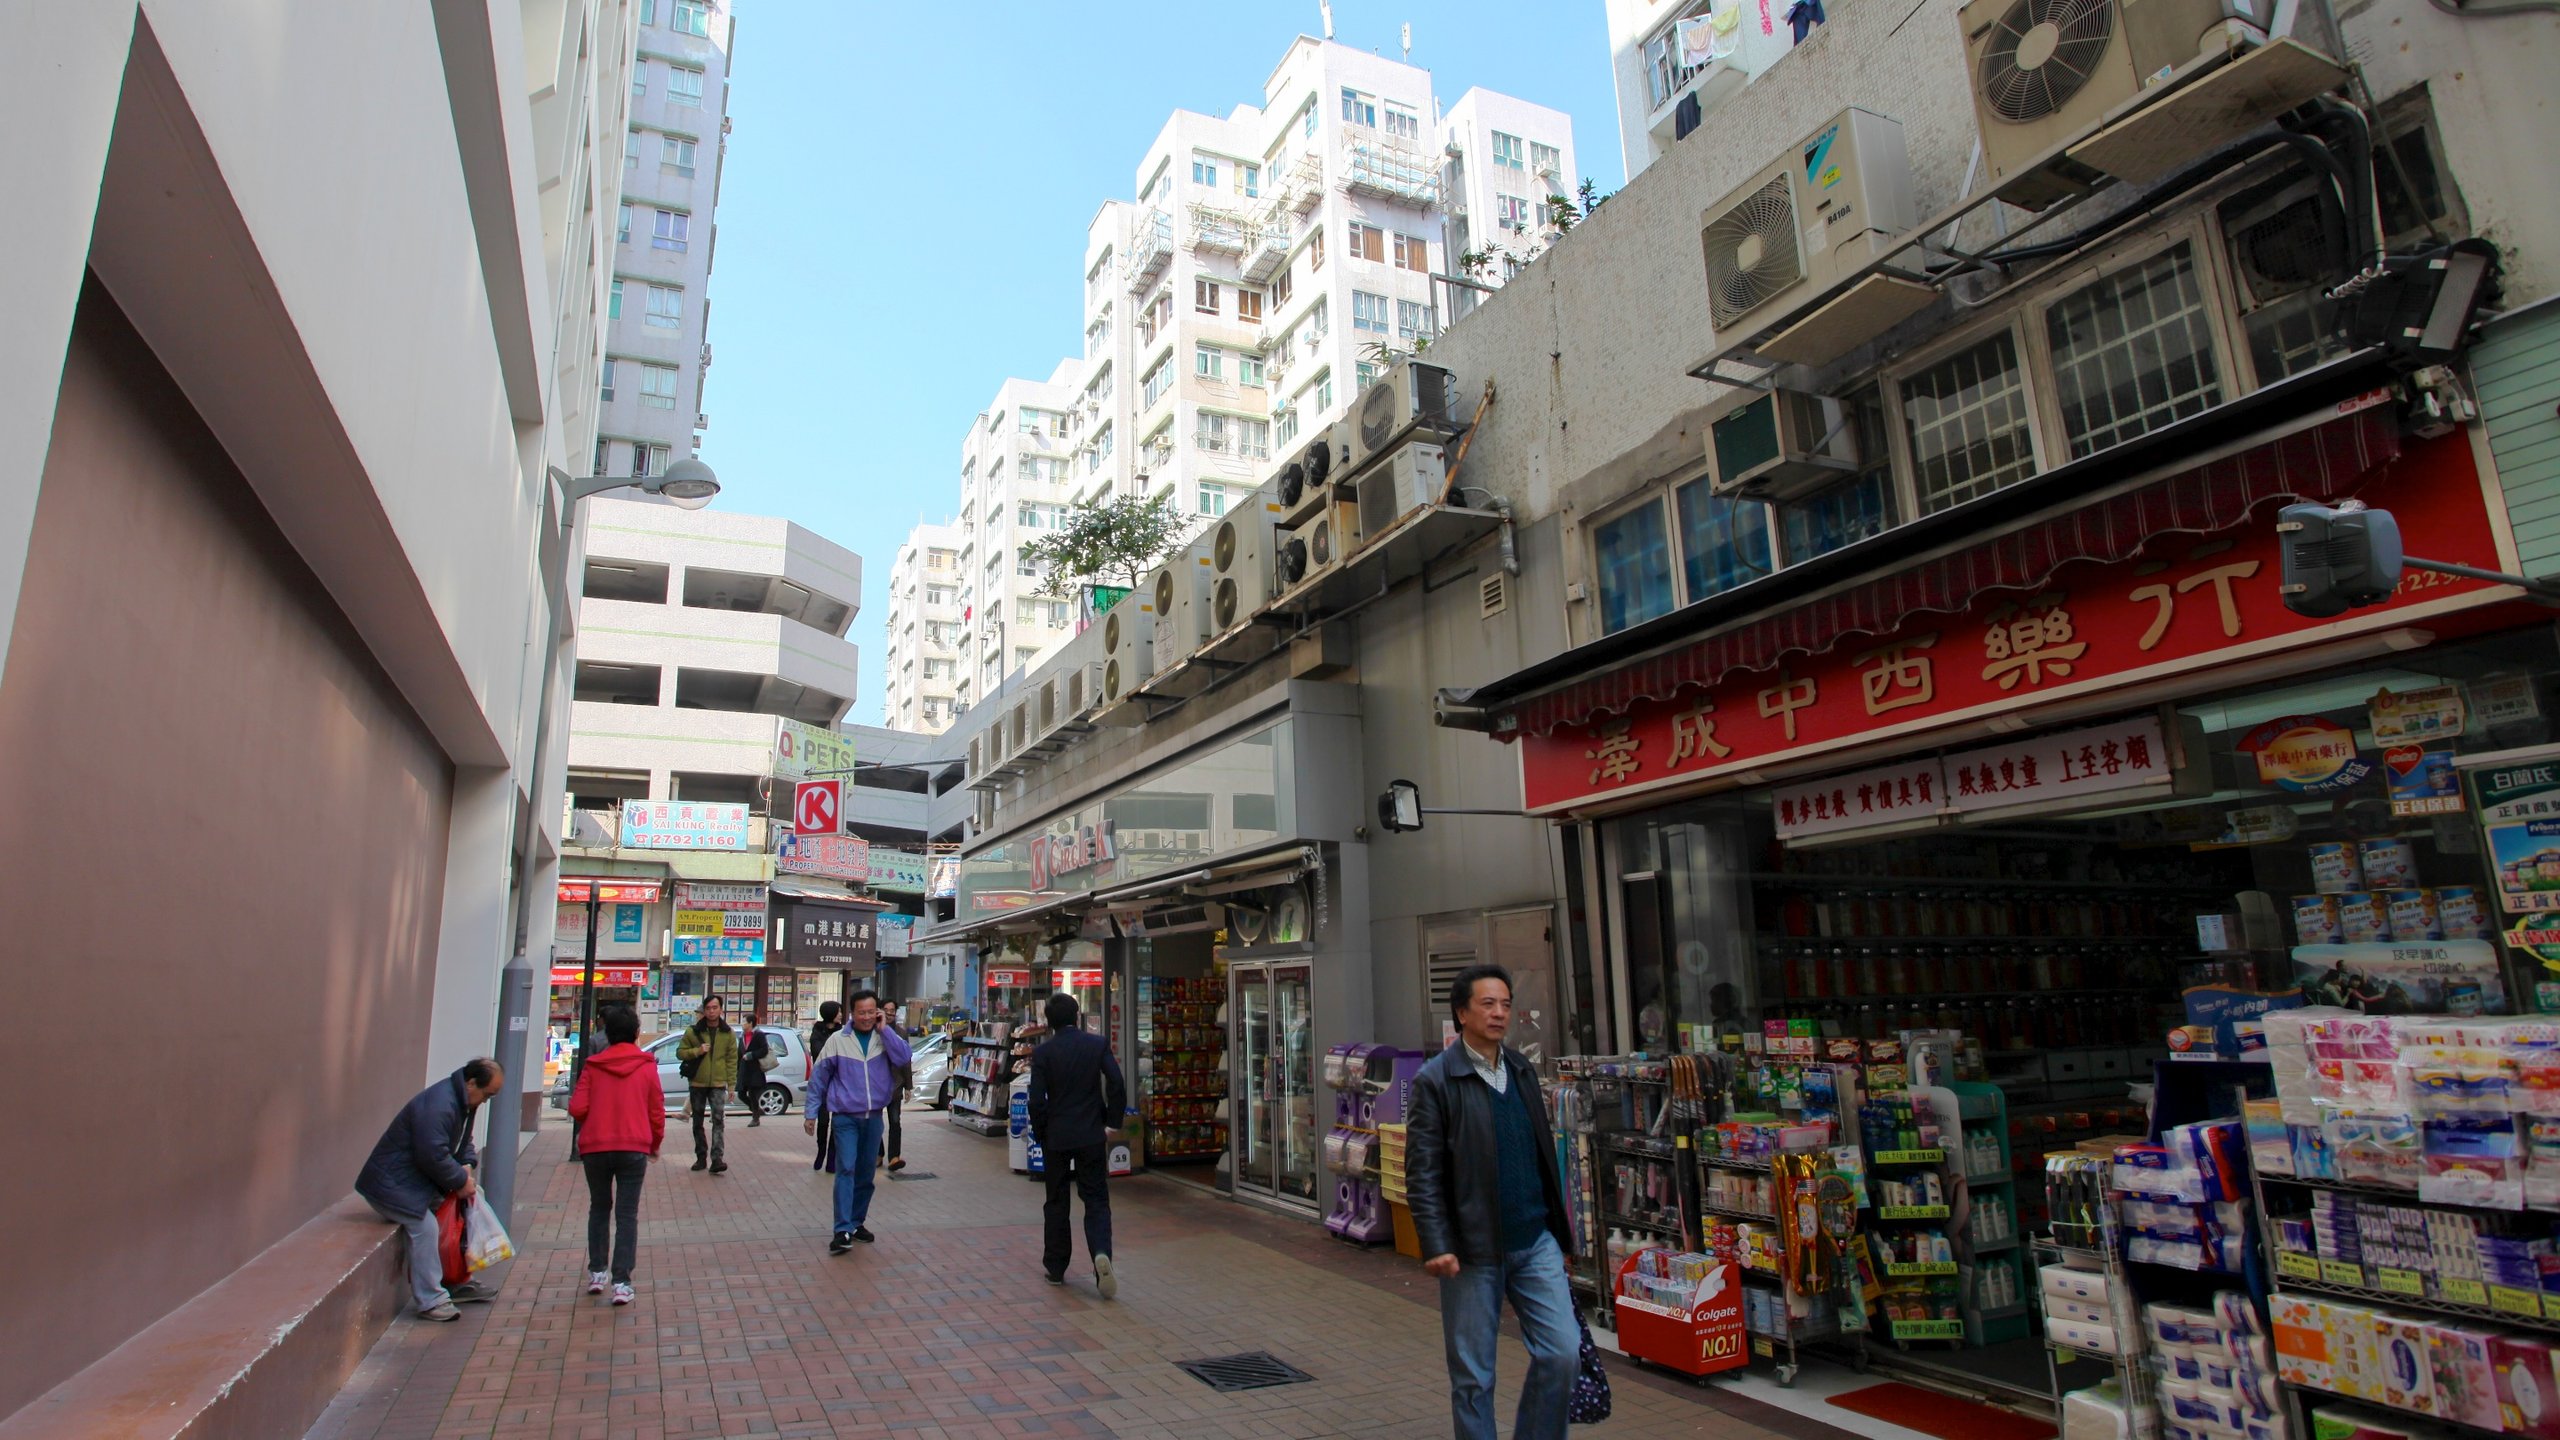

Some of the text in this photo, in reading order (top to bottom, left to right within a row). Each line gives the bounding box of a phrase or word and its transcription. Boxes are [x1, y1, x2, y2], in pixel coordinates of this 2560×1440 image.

[1804, 123, 1839, 153] DAIKIN
[1827, 204, 1852, 226] R410A
[2493, 766, 2554, 790] 白蘭氏
[653, 821, 743, 832] SAI KUNG Realty
[652, 834, 735, 846] 2792 1160
[724, 915, 762, 928] 2792 9899
[818, 920, 869, 939] 港基地產
[1696, 1306, 1737, 1322] Colgate
[1702, 1333, 1737, 1359] NO.1
